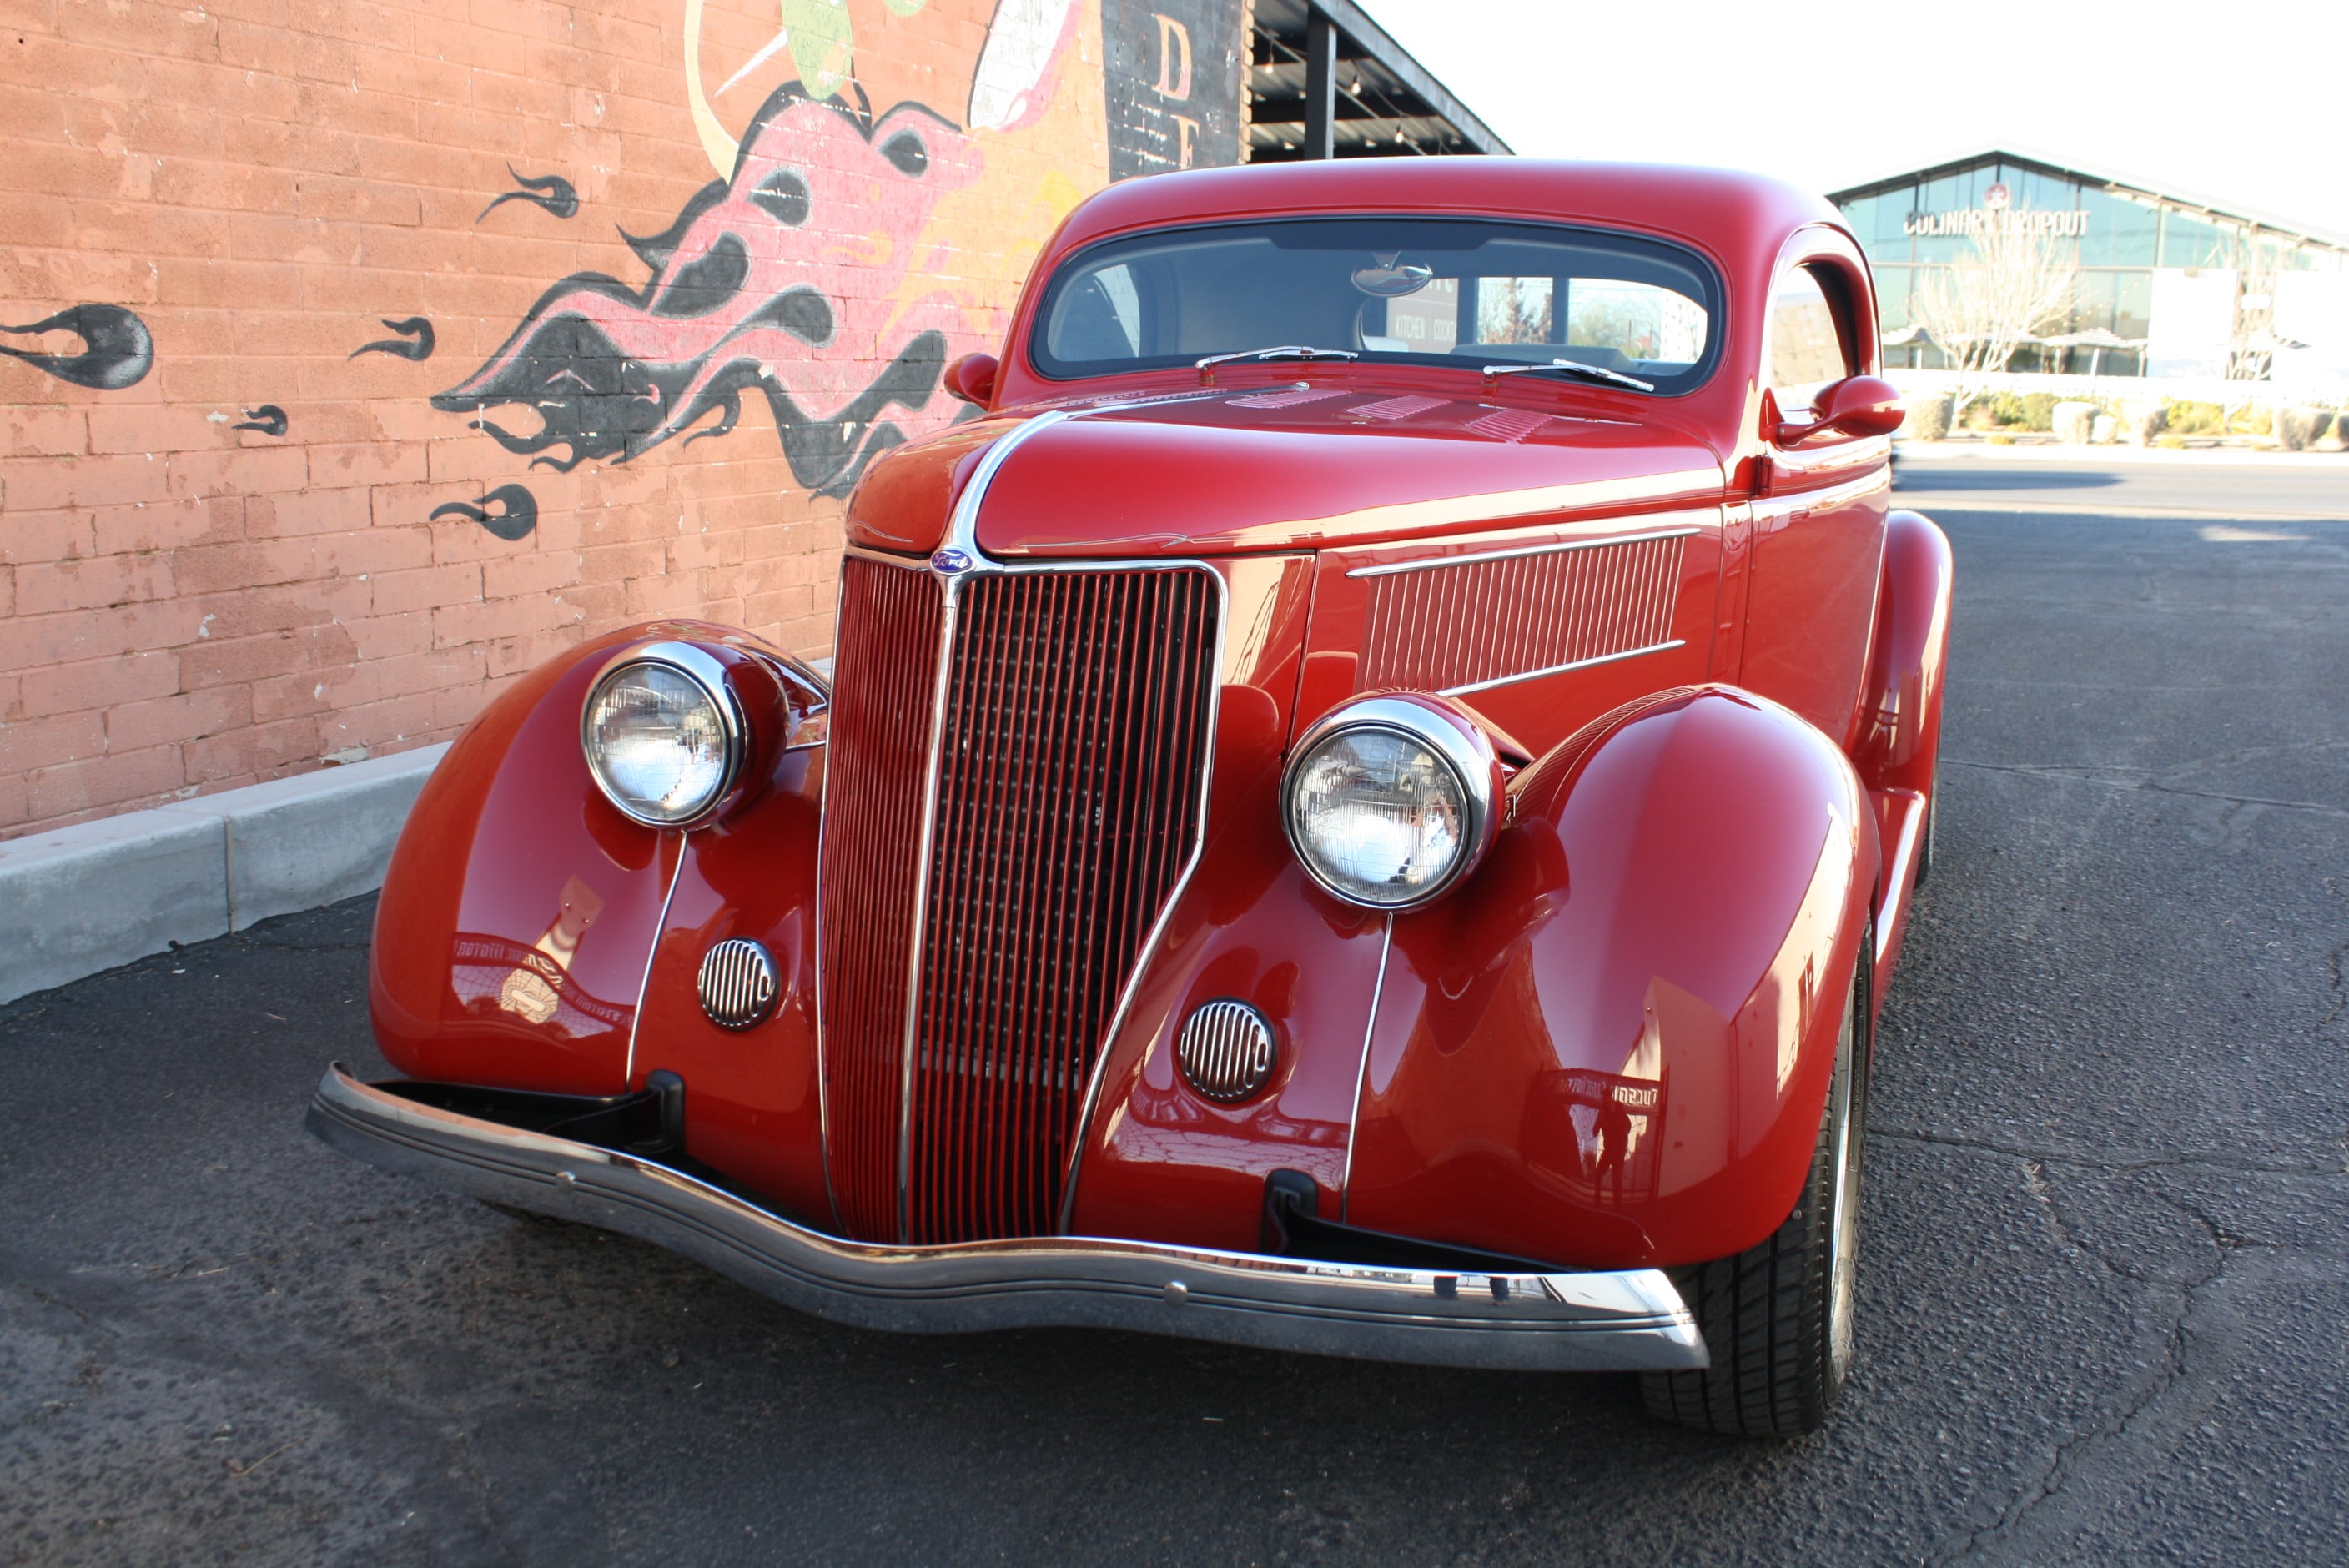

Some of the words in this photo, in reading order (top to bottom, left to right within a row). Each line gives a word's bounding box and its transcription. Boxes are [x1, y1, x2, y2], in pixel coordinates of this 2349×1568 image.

[1903, 209, 1996, 236] CULINARY
[2001, 209, 2090, 237] DROPOUT
[1395, 314, 1426, 339] KITCHEN
[933, 550, 968, 569] Ford
